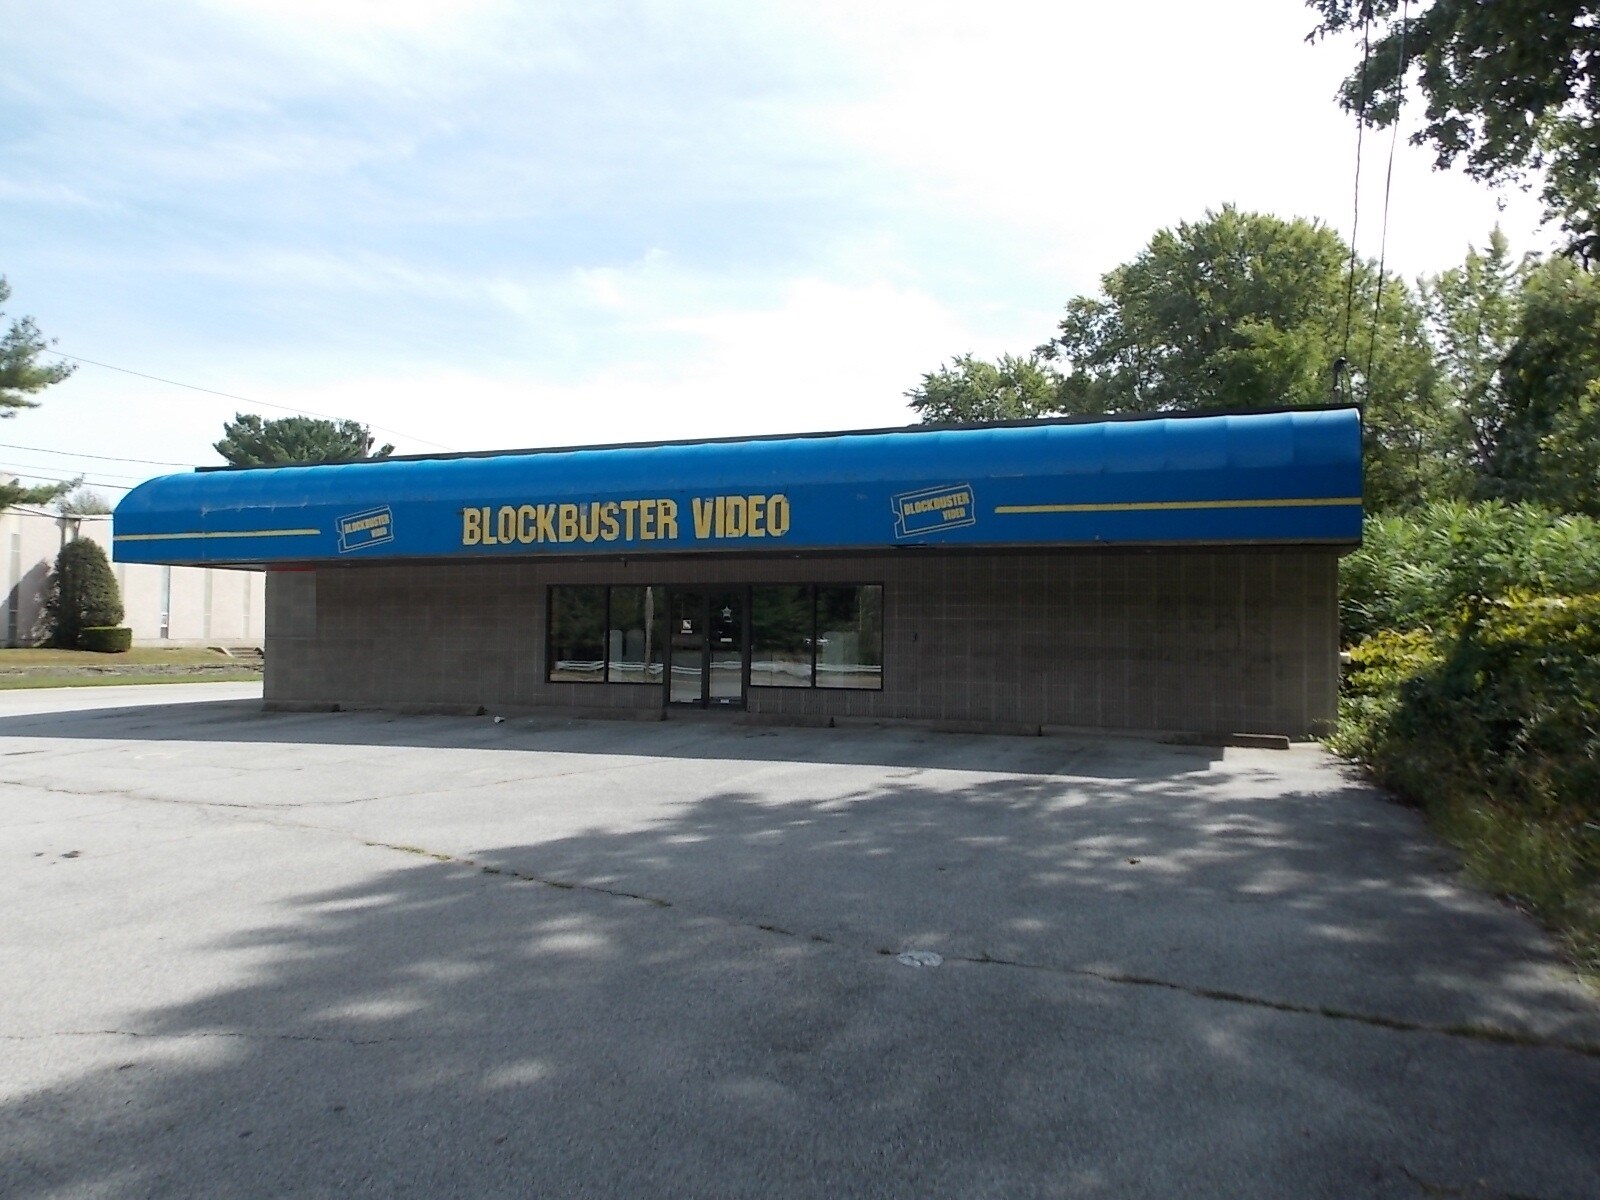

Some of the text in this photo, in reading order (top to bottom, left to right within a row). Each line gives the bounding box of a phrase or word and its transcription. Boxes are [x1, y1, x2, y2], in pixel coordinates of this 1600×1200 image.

[462, 494, 790, 545] BLOCKBUSTER VIDEO
[904, 492, 970, 515] BLOCKBUSTER
